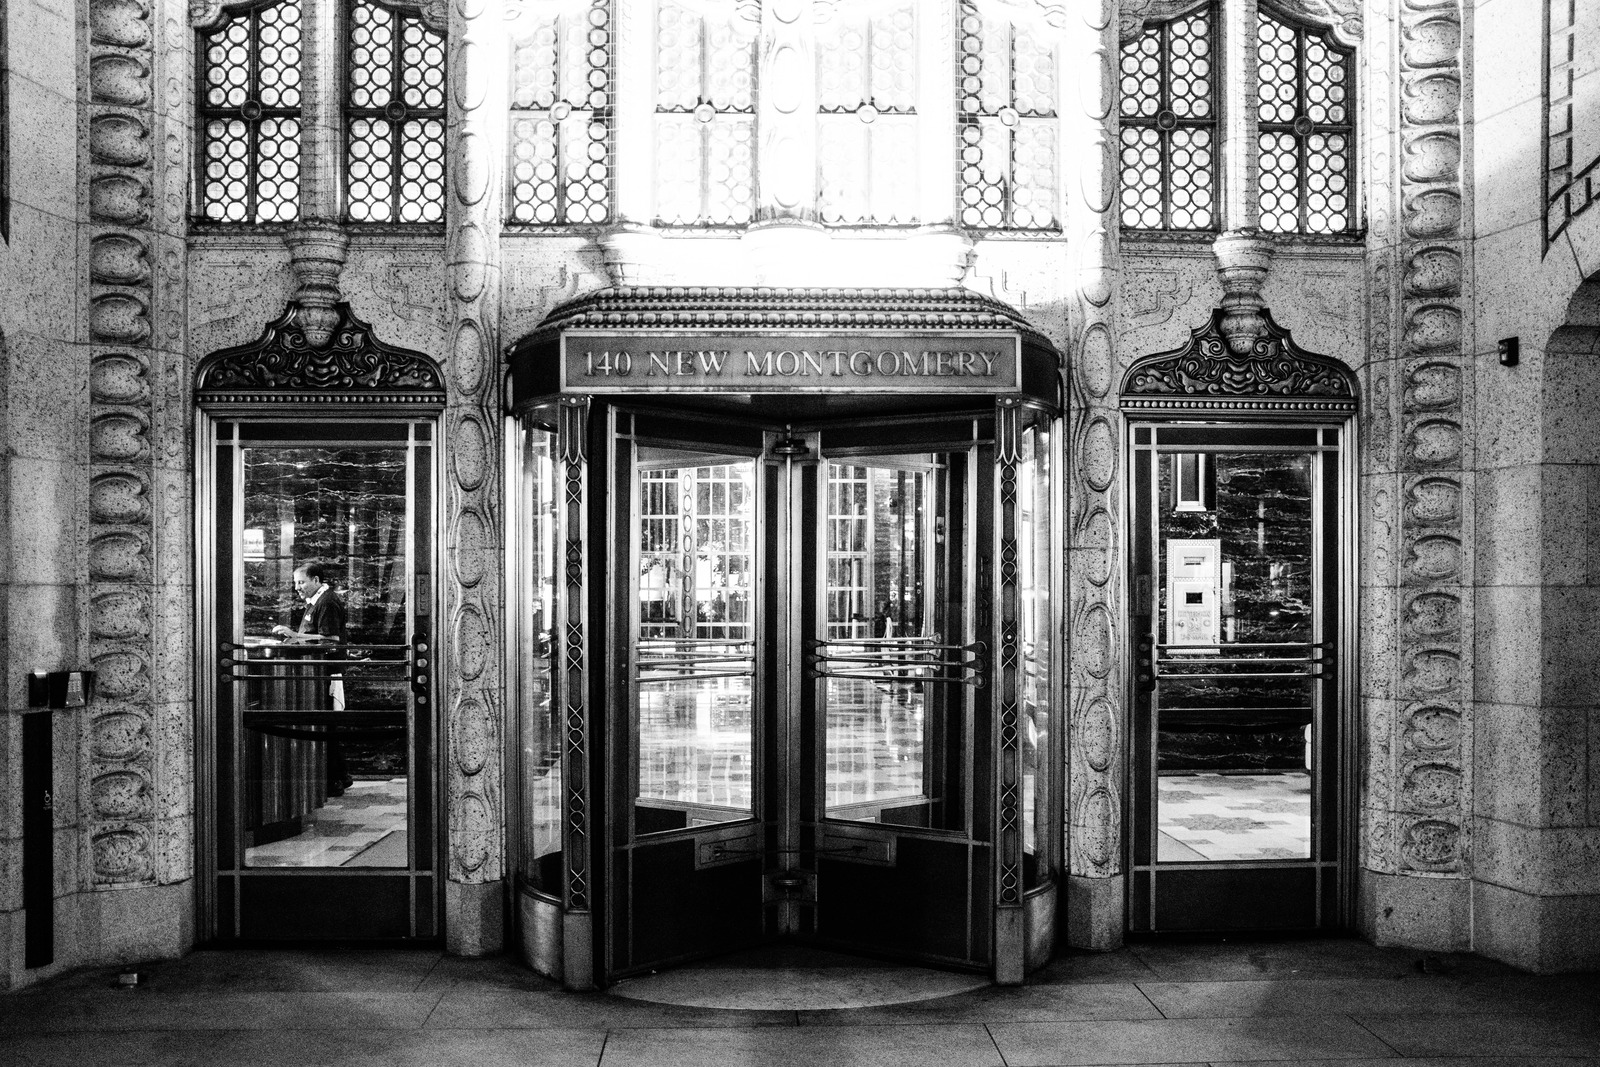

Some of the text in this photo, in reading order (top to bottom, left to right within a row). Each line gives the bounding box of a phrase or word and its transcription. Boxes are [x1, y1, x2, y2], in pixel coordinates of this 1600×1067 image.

[585, 350, 999, 376] 140 NEW MONTGOMERY
